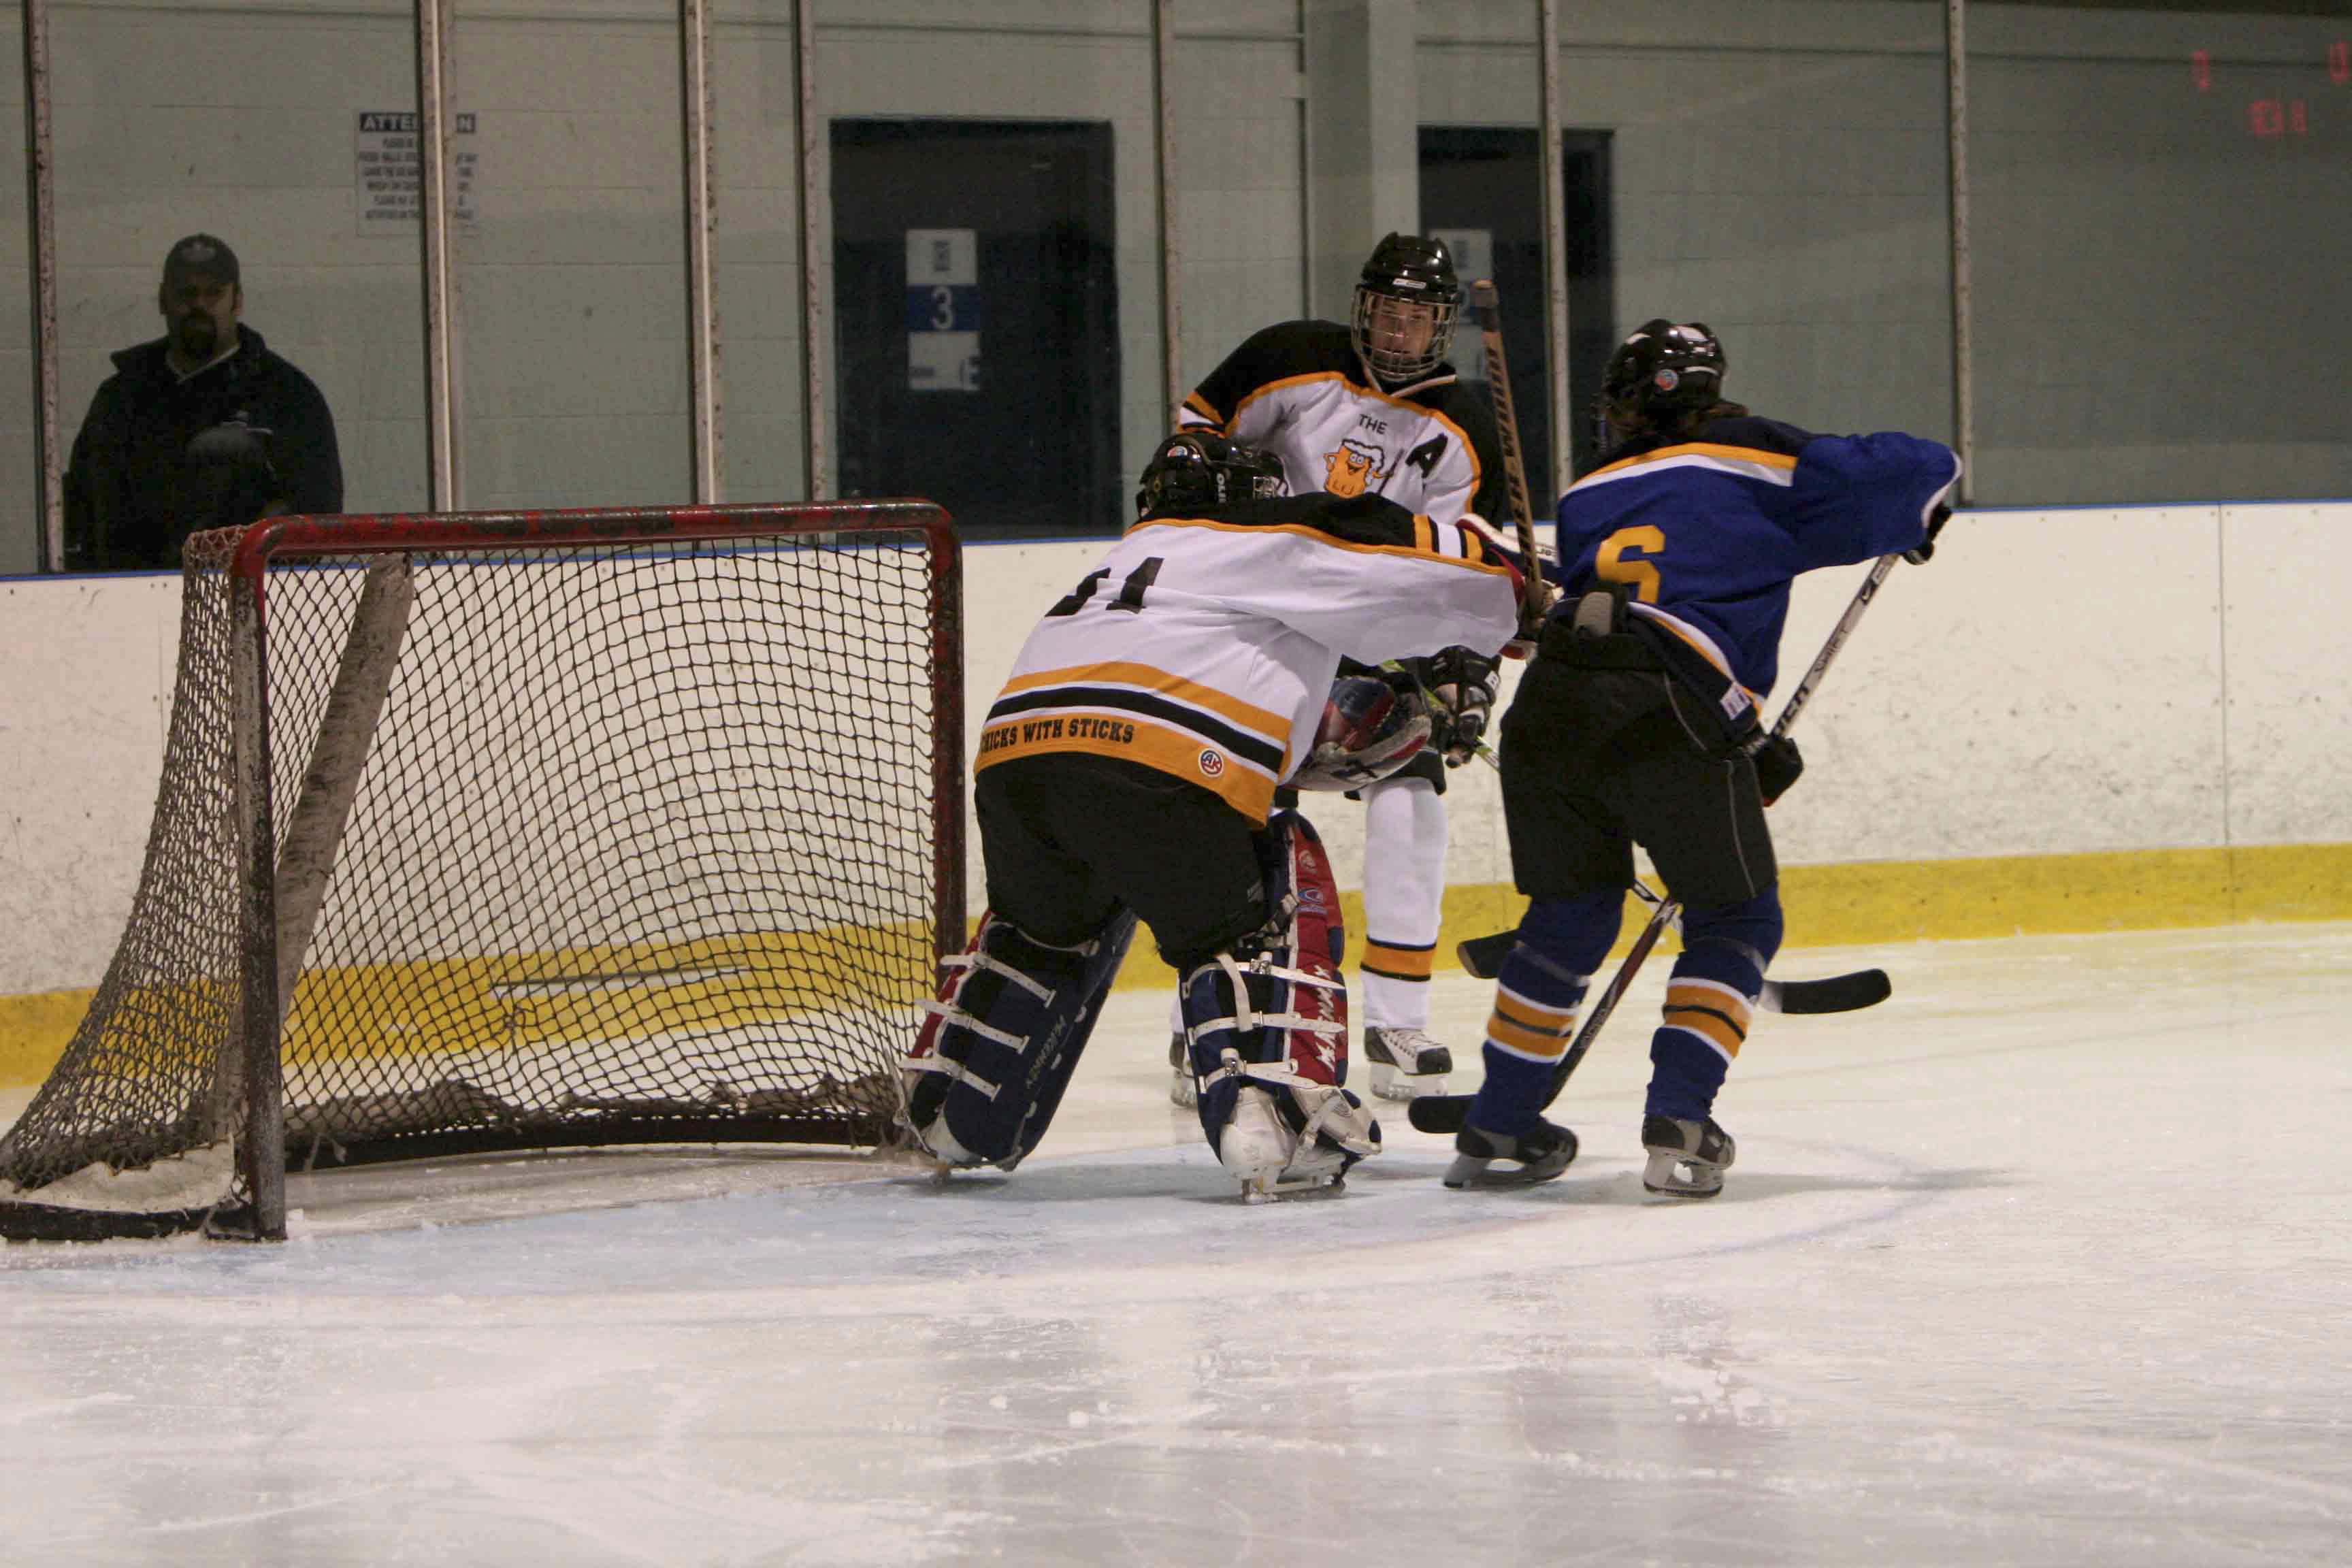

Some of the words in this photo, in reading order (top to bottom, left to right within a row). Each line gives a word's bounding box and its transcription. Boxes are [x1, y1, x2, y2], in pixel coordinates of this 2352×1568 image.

[932, 286, 953, 329] 3
[1359, 413, 1388, 435] THE
[1024, 719, 1064, 743] WITH
[1068, 718, 1134, 744] STICKS
